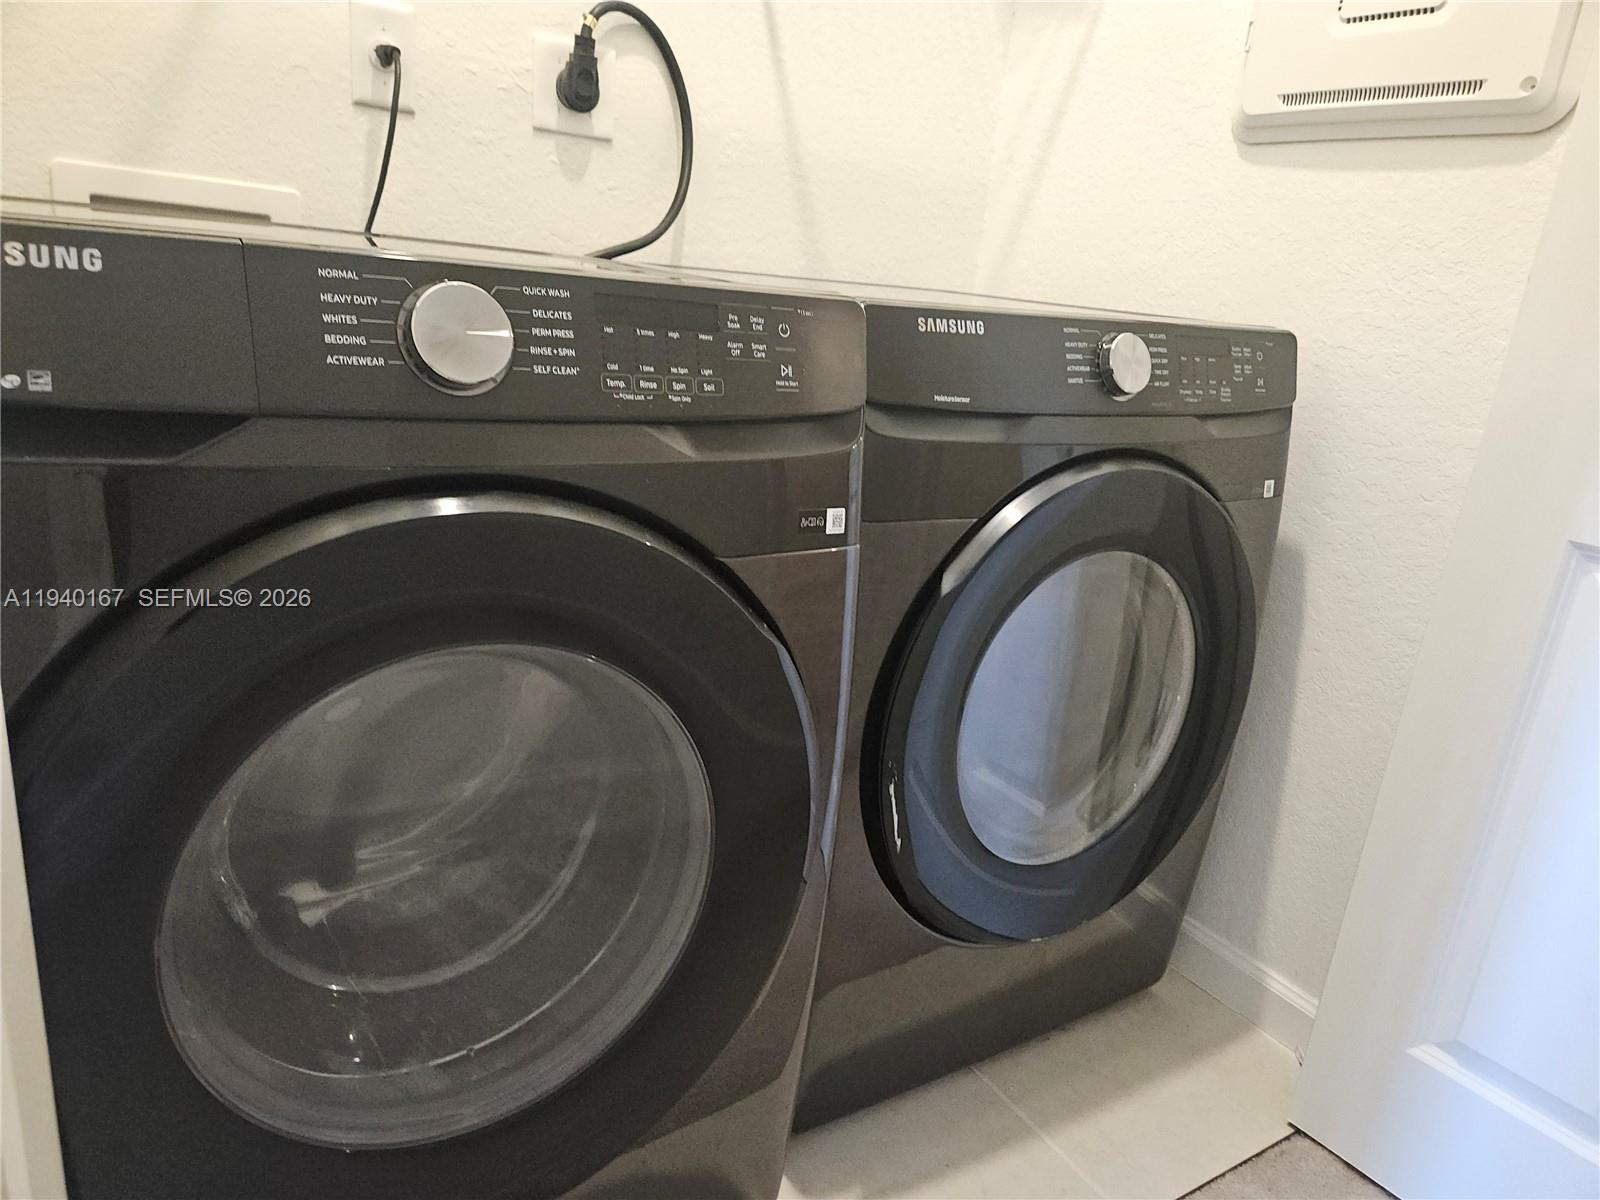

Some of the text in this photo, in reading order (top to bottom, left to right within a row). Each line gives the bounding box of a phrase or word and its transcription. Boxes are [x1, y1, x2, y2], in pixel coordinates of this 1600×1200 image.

[318, 268, 359, 280] NORMAL
[522, 285, 570, 298] QUICK WASH
[320, 293, 378, 306] HEAVY DUTY
[322, 313, 358, 325] WHITES
[532, 309, 573, 320] DELICATES
[728, 313, 738, 321] Pre
[727, 321, 741, 329] Soak
[749, 315, 765, 325] Delay
[752, 324, 763, 332] End
[917, 317, 985, 335] SAMSUNG
[531, 327, 574, 339] PERM PRESS
[698, 333, 713, 342] Heavy
[324, 333, 367, 346] BEDDING
[727, 341, 744, 350] Alarm
[751, 342, 767, 351] Smart
[731, 349, 740, 357] Off
[753, 350, 766, 359] Care
[326, 354, 385, 367] ACTIVEWEAR
[533, 364, 551, 374] SELF
[606, 362, 619, 371] Cold
[700, 367, 713, 376] Light
[606, 378, 626, 389] Temp.
[639, 380, 658, 390] Rinse
[672, 381, 687, 391] Spin
[703, 382, 716, 392] Soil
